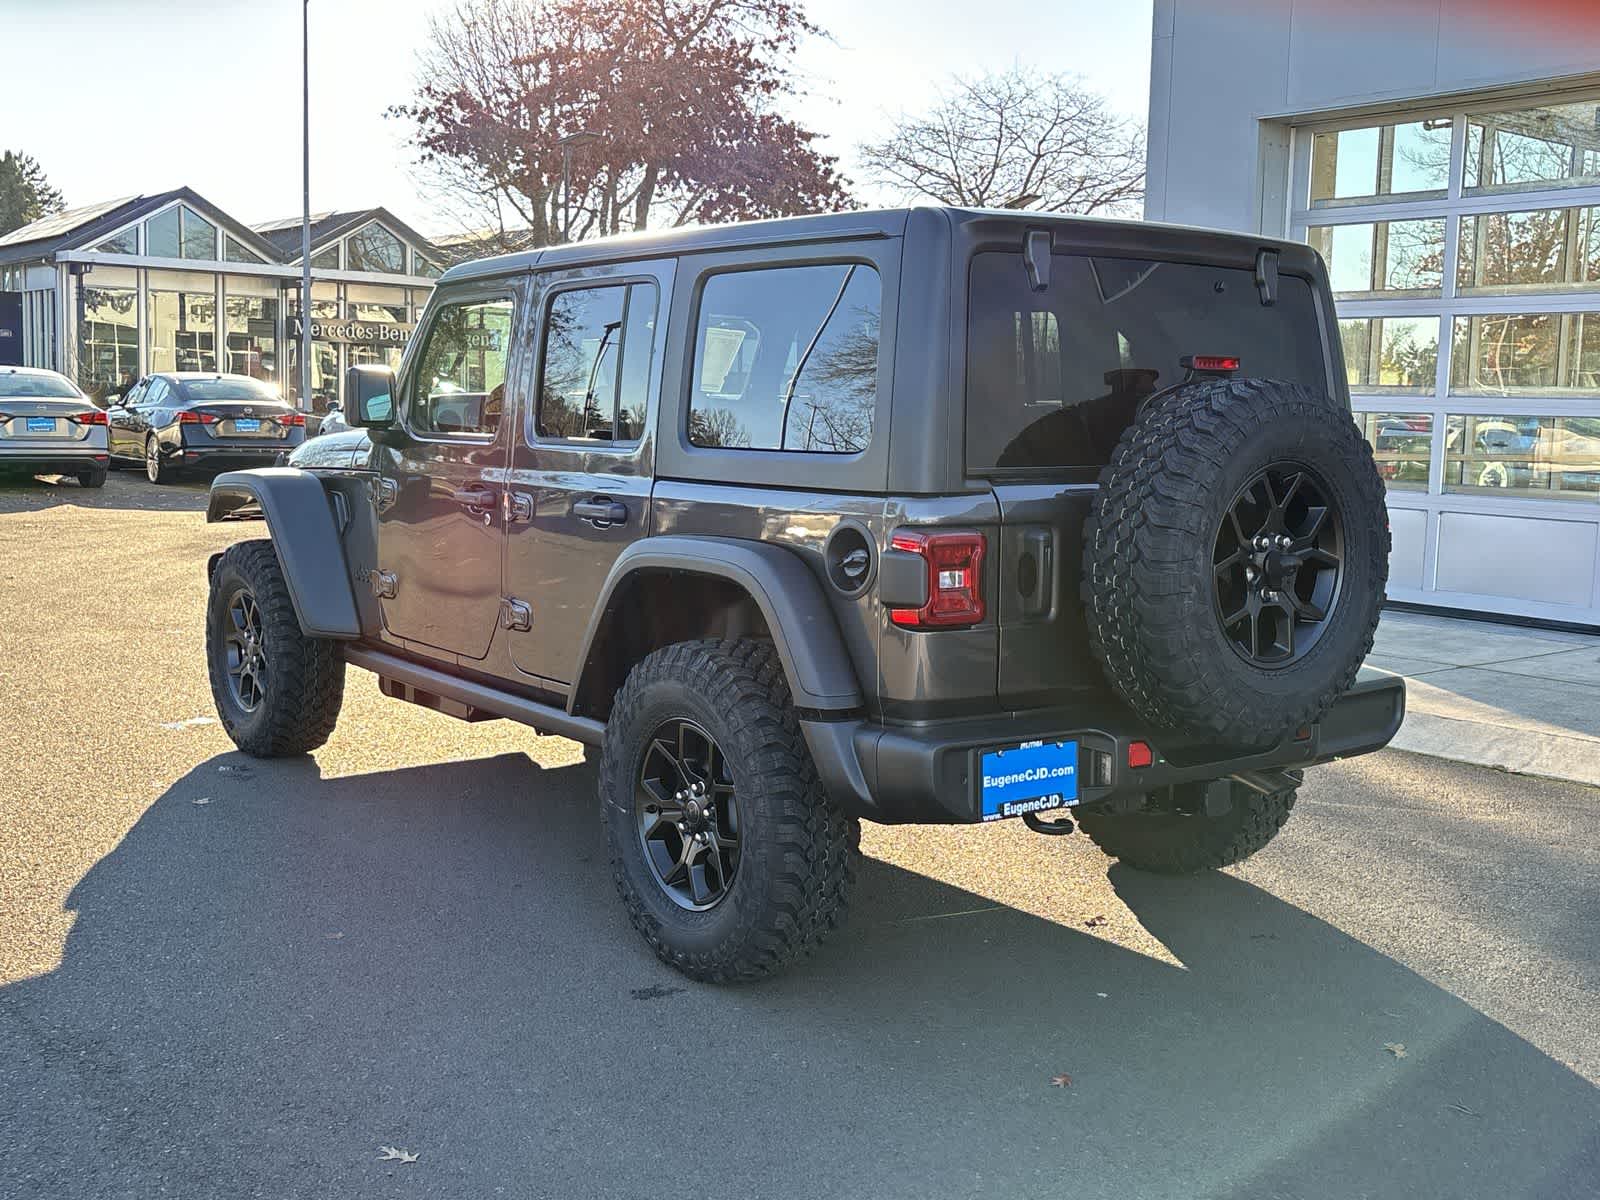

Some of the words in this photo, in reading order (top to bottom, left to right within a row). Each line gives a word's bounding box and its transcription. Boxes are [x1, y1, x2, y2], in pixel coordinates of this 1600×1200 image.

[293, 319, 412, 341] Mercedes-Ben
[983, 766, 1074, 788] EugeneCJD.com
[1003, 794, 1060, 816] EugeneCJD
